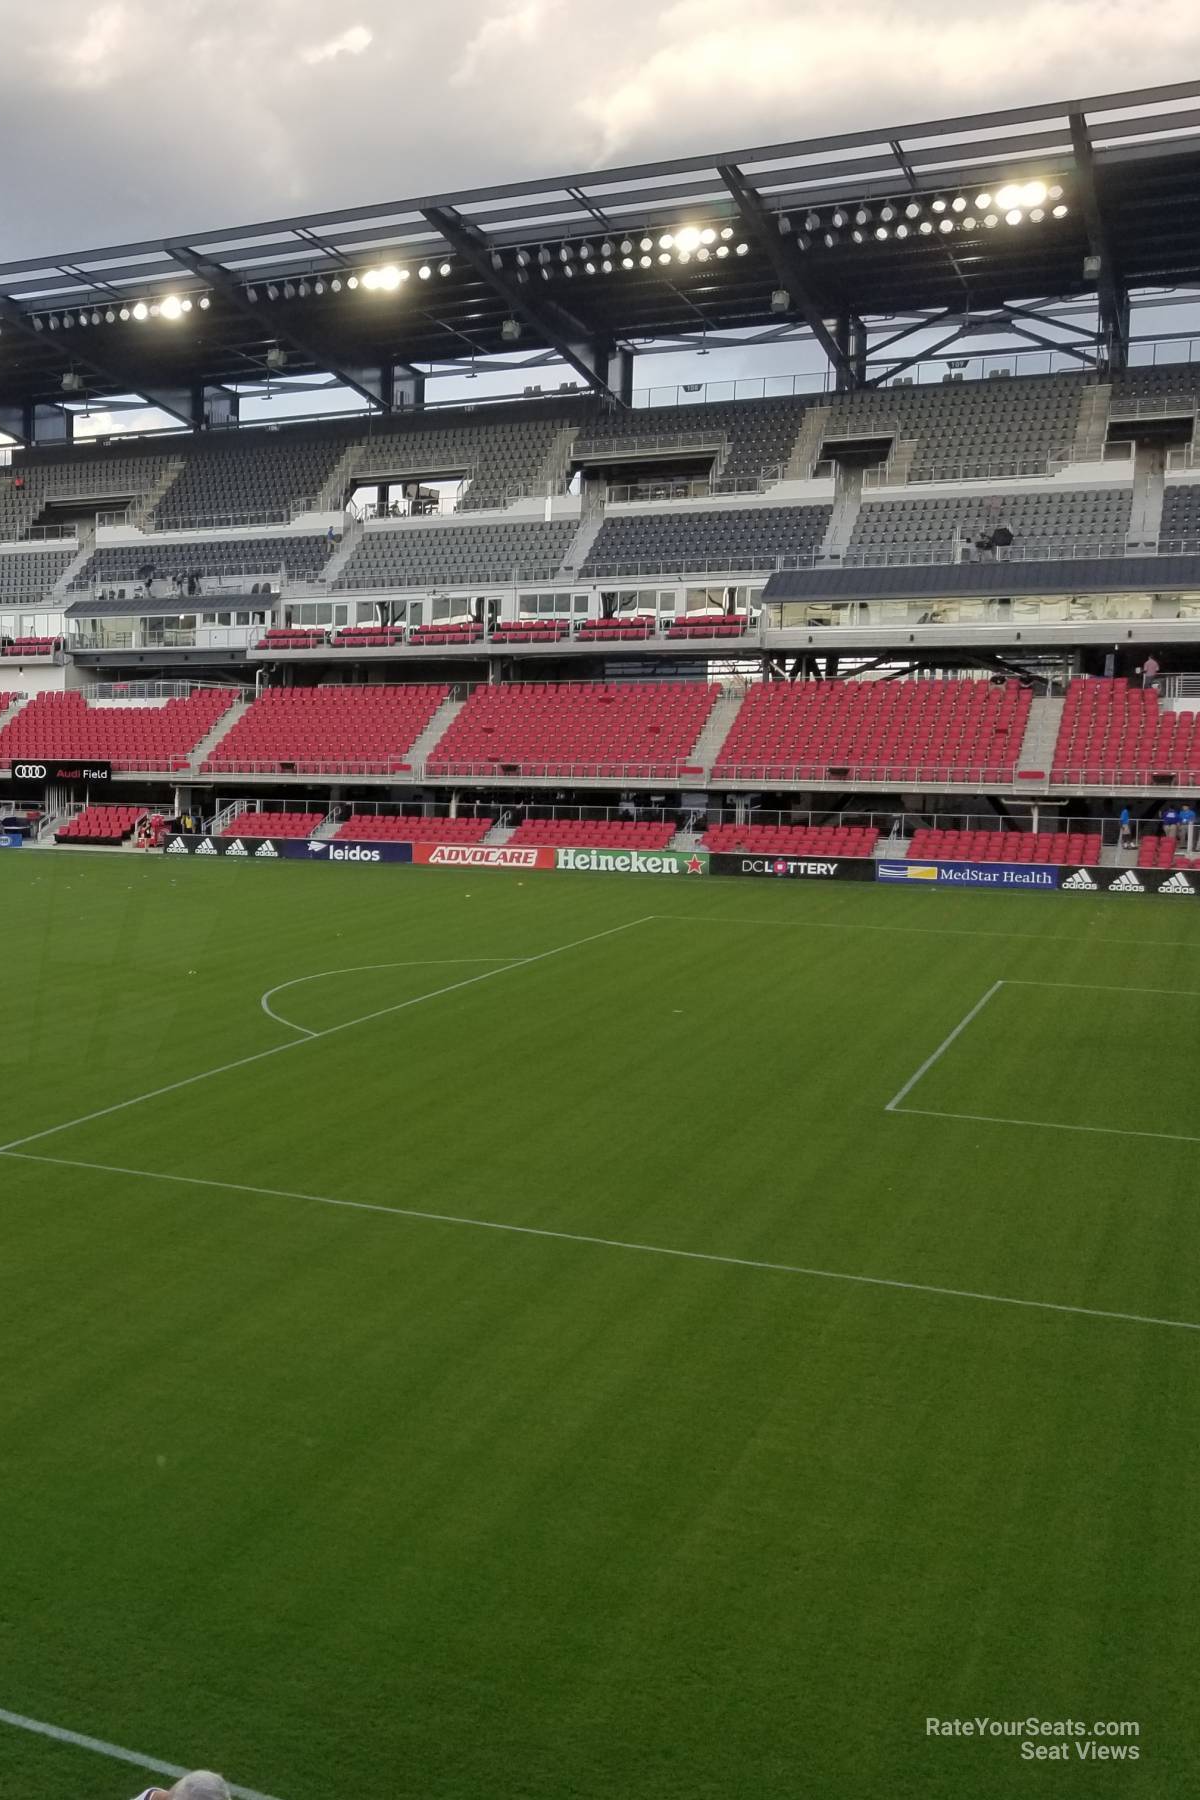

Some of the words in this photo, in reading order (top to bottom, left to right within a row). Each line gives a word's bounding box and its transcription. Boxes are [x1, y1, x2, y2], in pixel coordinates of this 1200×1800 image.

[57, 769, 81, 779] Audi
[83, 769, 108, 779] Field
[166, 846, 189, 854] adidas
[194, 847, 218, 855] adidas
[225, 848, 248, 856] adidas
[255, 849, 279, 857] adidas
[329, 845, 381, 862] leidos
[429, 846, 538, 867] ADVOCARE
[556, 848, 679, 874] Heineken
[940, 868, 1000, 882] MedStar
[1003, 870, 1053, 884] Health
[1062, 879, 1098, 891] adidas
[1108, 881, 1145, 893] adidas
[1158, 883, 1196, 895] adidas
